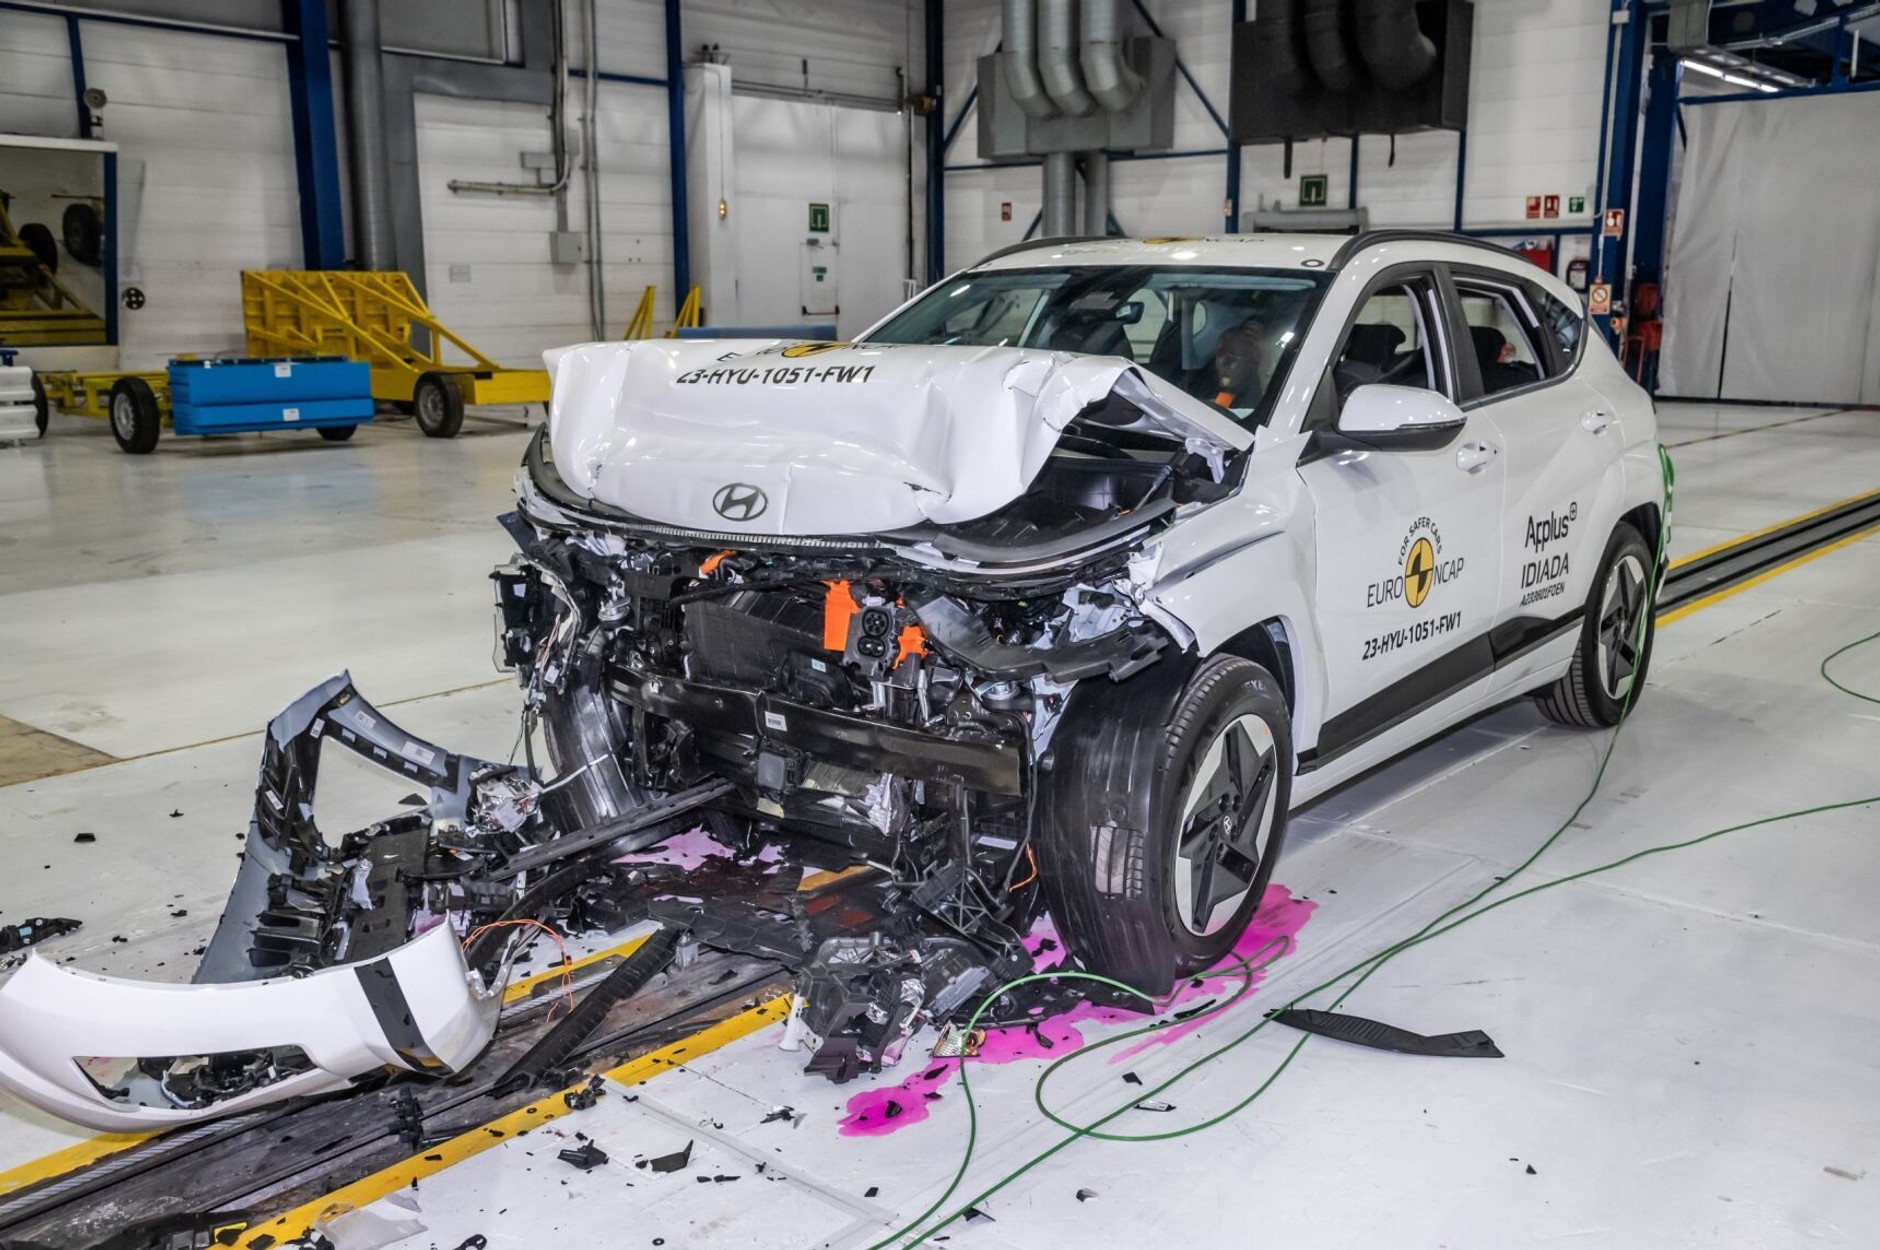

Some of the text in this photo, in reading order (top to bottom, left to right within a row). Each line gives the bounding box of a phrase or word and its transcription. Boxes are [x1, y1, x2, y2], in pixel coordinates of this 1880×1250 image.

[1398, 516, 1443, 565] FOR SAFER CARS
[1367, 557, 1465, 608] EURO NCAP
[1521, 552, 1569, 589] IDIADA
[1362, 611, 1462, 661] 23-HYU-1051-FW1
